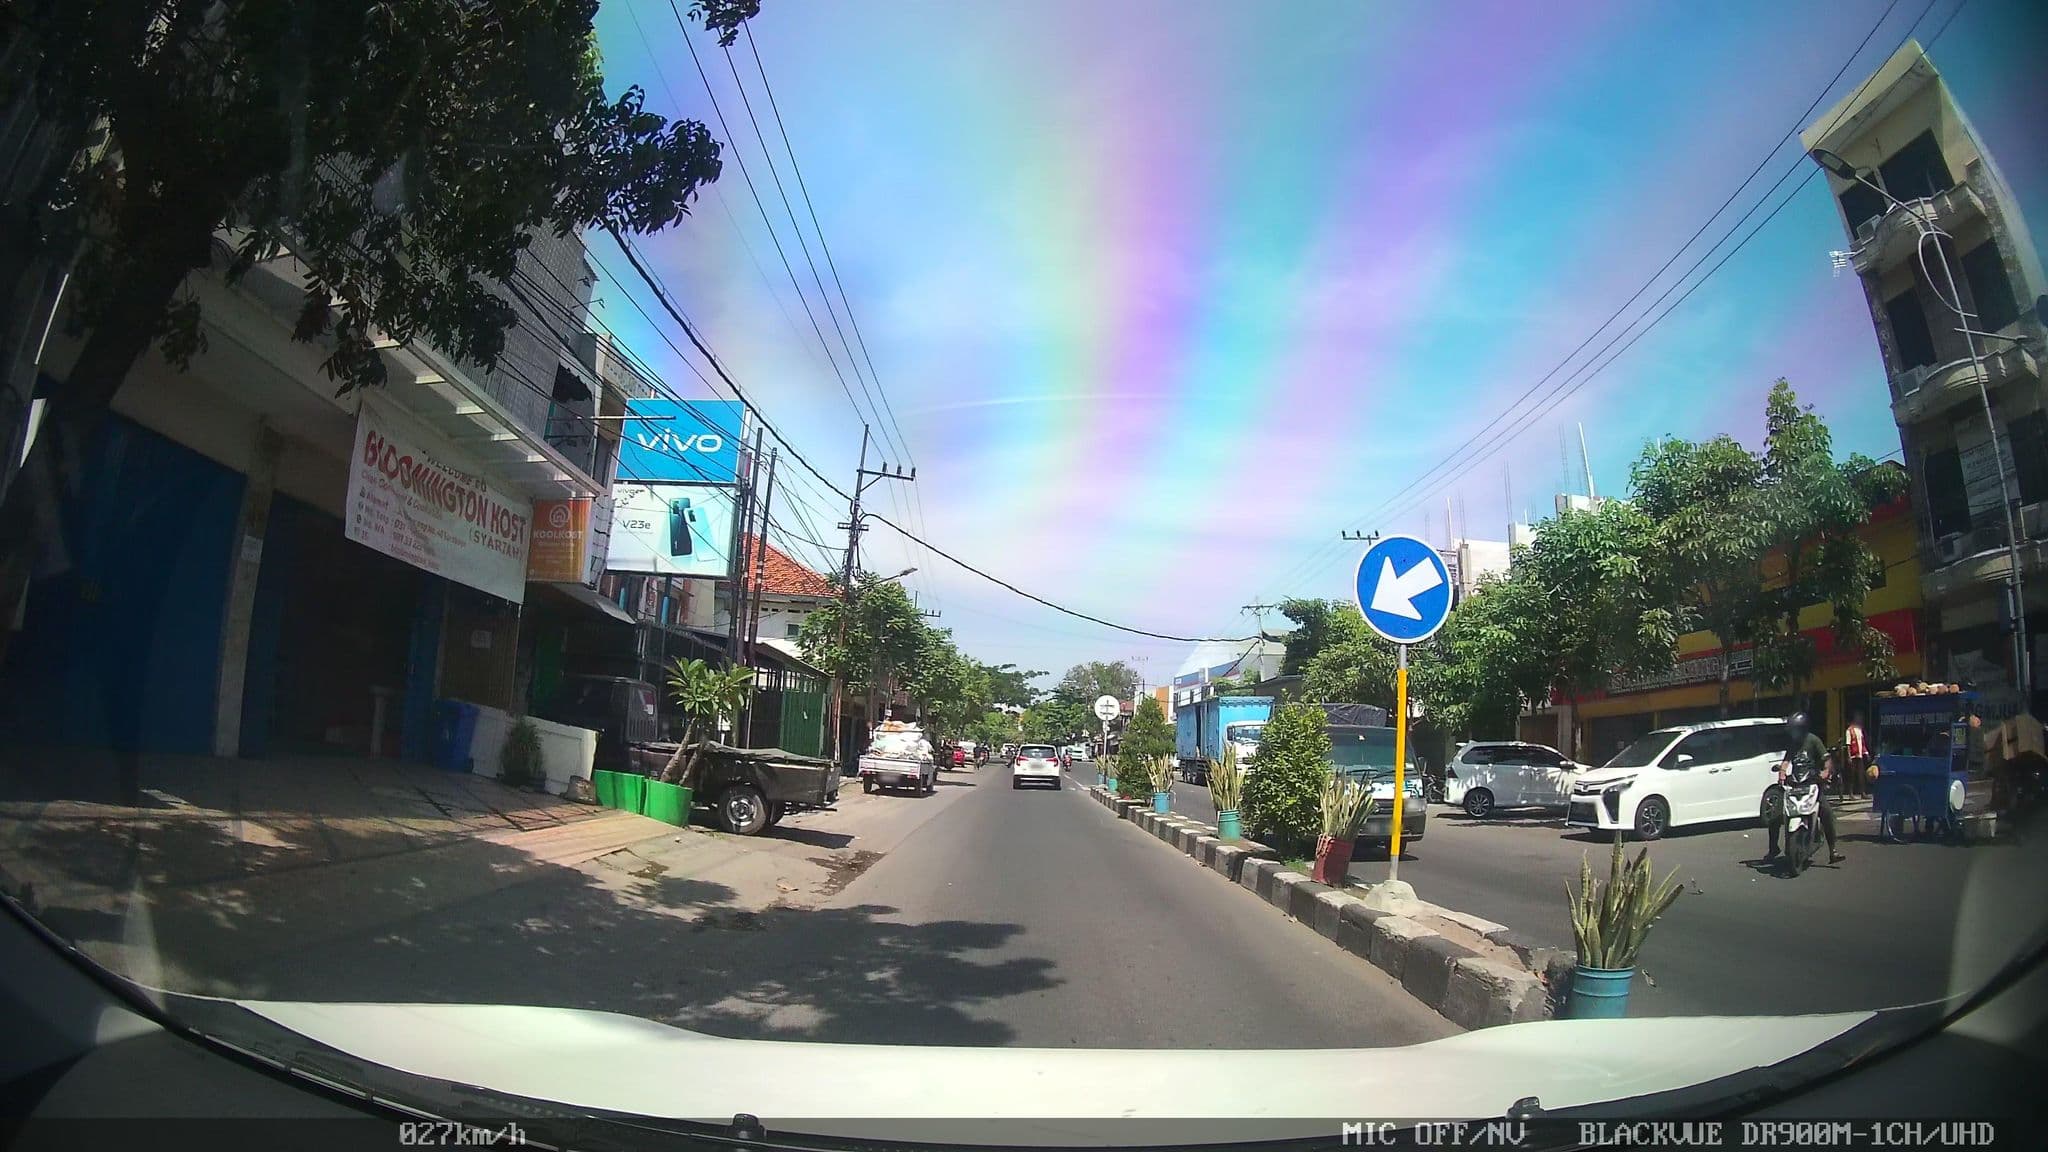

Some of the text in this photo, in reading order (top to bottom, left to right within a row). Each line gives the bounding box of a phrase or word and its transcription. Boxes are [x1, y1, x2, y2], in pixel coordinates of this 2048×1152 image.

[637, 428, 723, 453] vivo
[364, 430, 489, 529] BLOOMINGTON
[491, 502, 526, 545] KOST
[623, 519, 651, 530] V23e
